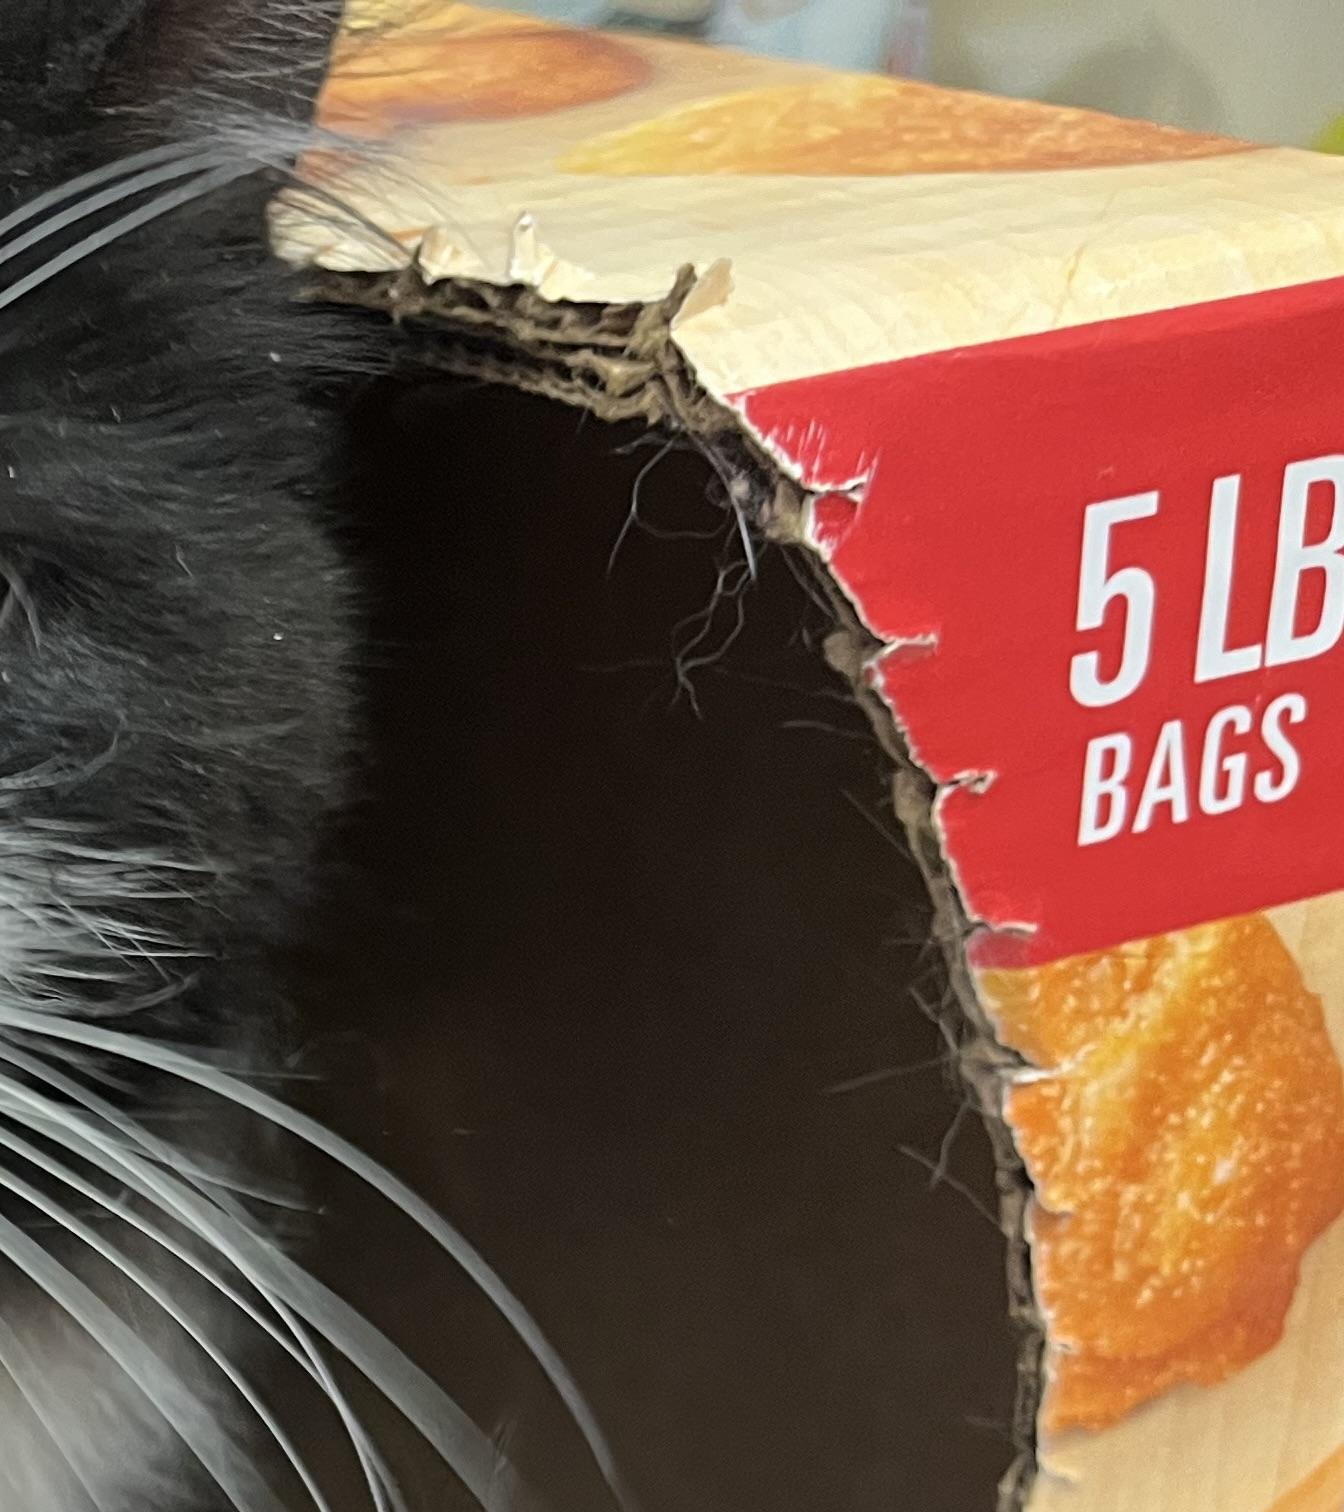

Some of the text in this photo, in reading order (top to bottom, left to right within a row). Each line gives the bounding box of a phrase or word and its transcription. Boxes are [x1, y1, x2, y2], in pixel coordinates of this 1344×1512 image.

[1069, 454, 1344, 708] 5 LB
[1077, 693, 1308, 847] BAGS
